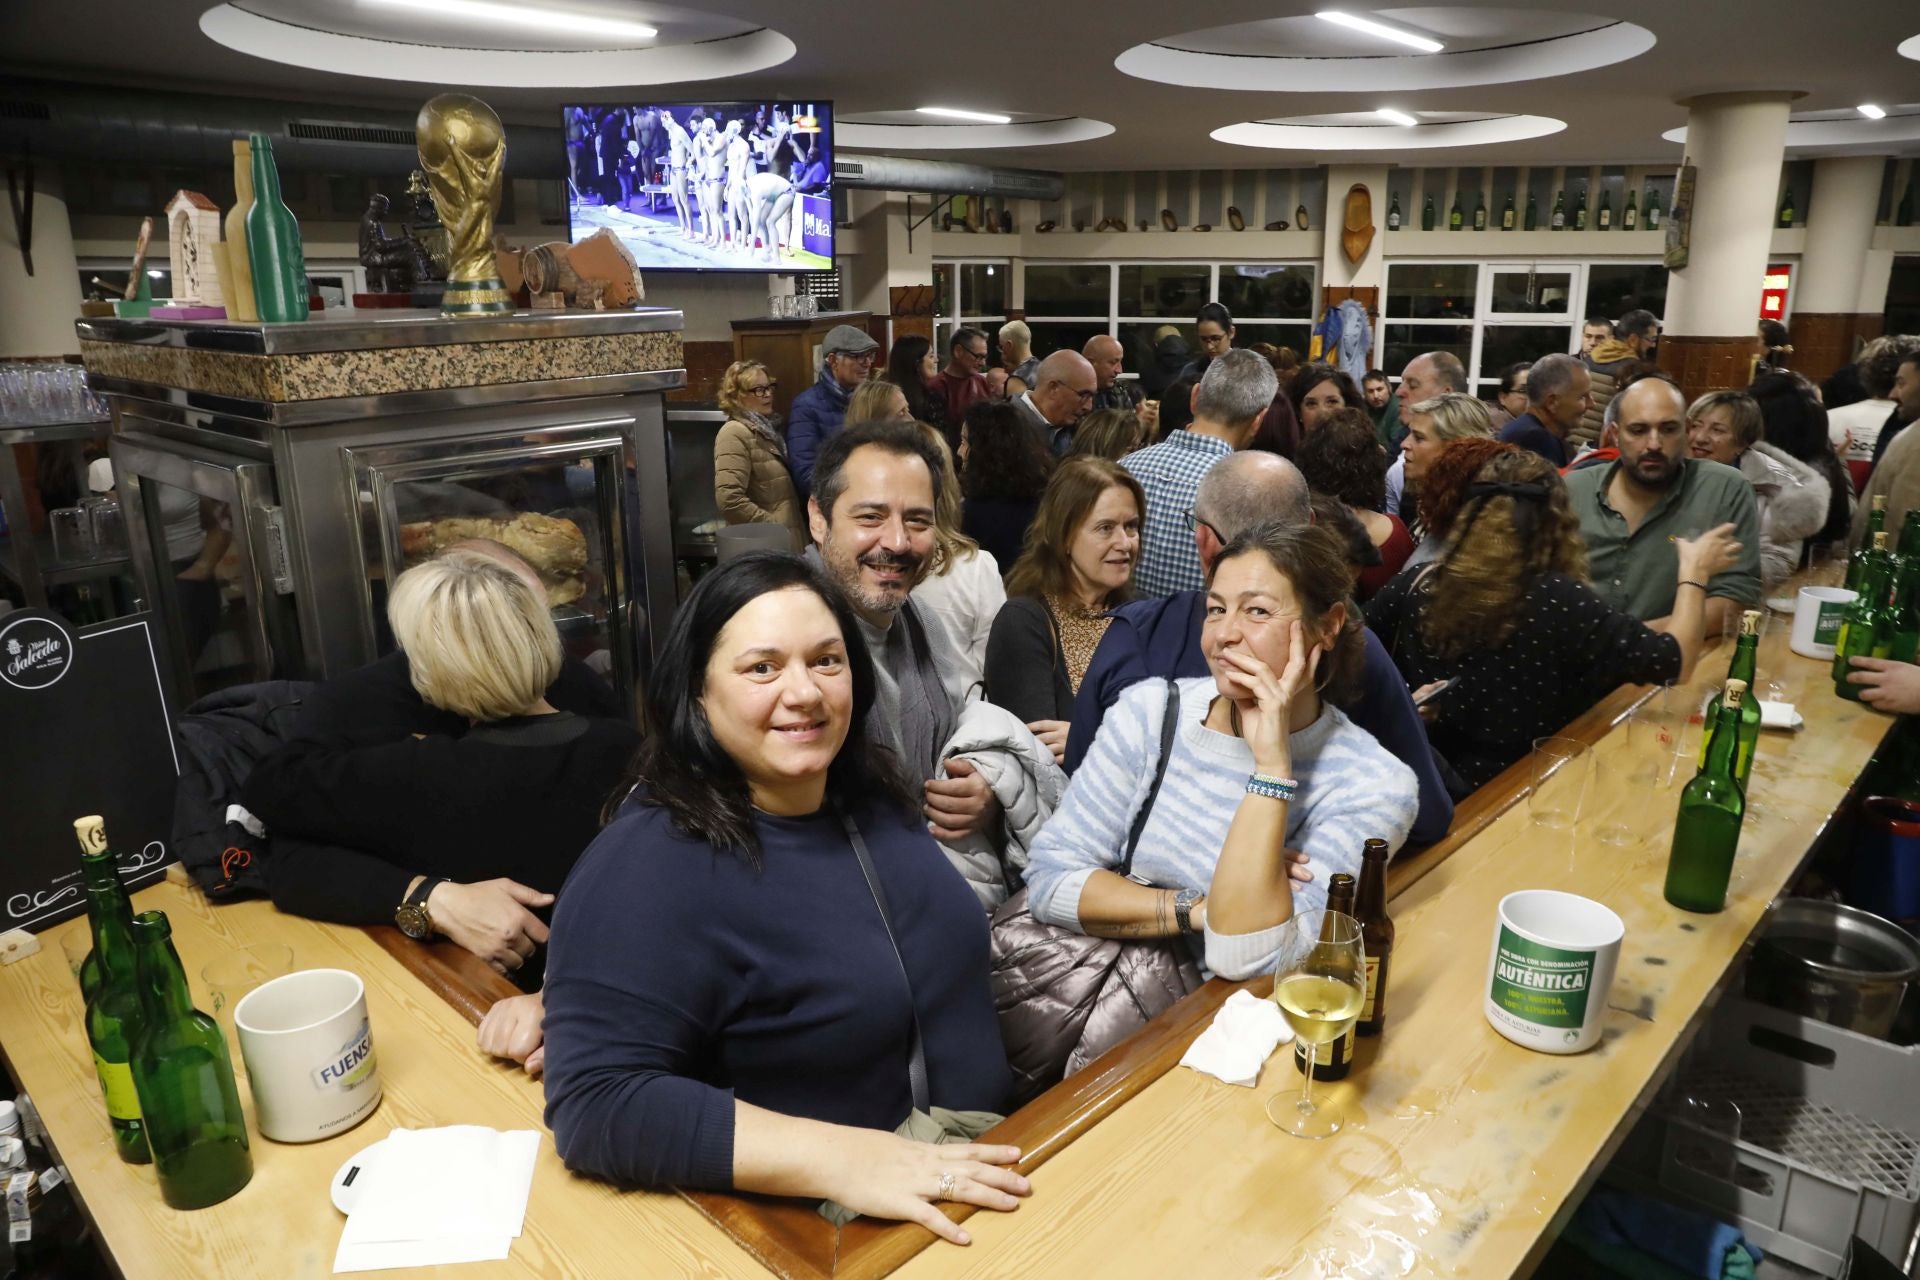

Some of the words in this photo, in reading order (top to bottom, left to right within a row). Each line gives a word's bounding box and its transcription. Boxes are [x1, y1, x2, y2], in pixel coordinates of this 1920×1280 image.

[1526, 958, 1540, 966] CON
[1540, 959, 1589, 969] DENOMINACIÓN
[1498, 962, 1583, 989] AUTÉNTICA
